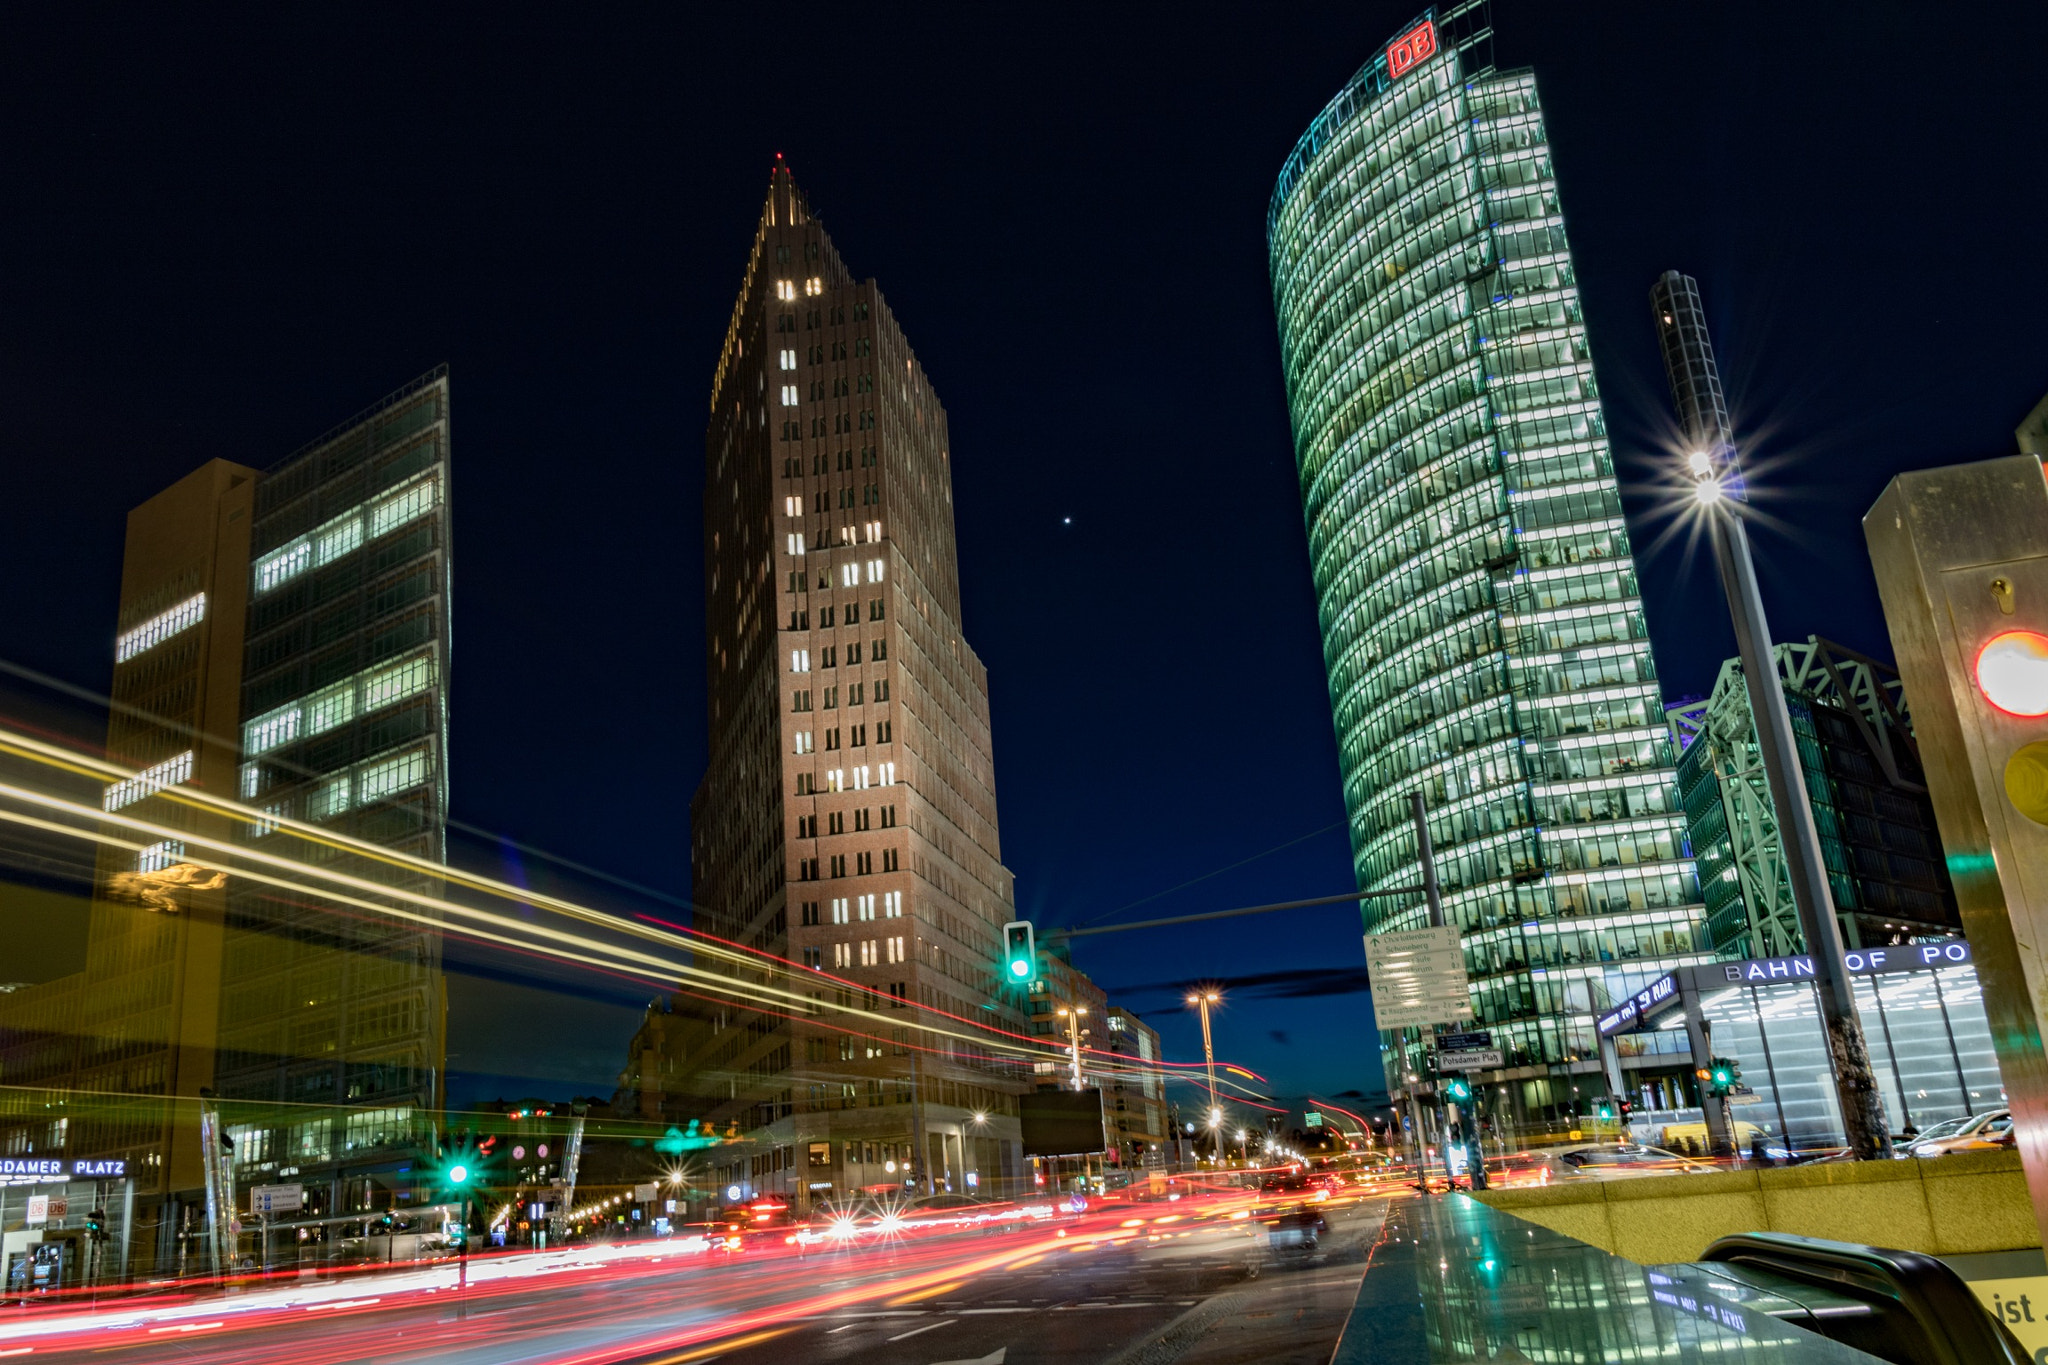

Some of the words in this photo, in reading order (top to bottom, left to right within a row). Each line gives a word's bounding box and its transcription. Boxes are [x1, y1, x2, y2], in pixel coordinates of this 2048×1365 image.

[1391, 28, 1432, 70] DB
[1384, 931, 1436, 944] Charlottenburg
[1725, 951, 1886, 982] BAHNOF
[1922, 944, 1967, 964] PO
[1443, 1056, 1480, 1065] Potsdamer
[0, 1160, 61, 1174] DAMER
[76, 1161, 125, 1174] PLATZ
[31, 1202, 44, 1215] DB
[49, 1201, 66, 1215] DB
[1993, 1293, 2035, 1324] ist
